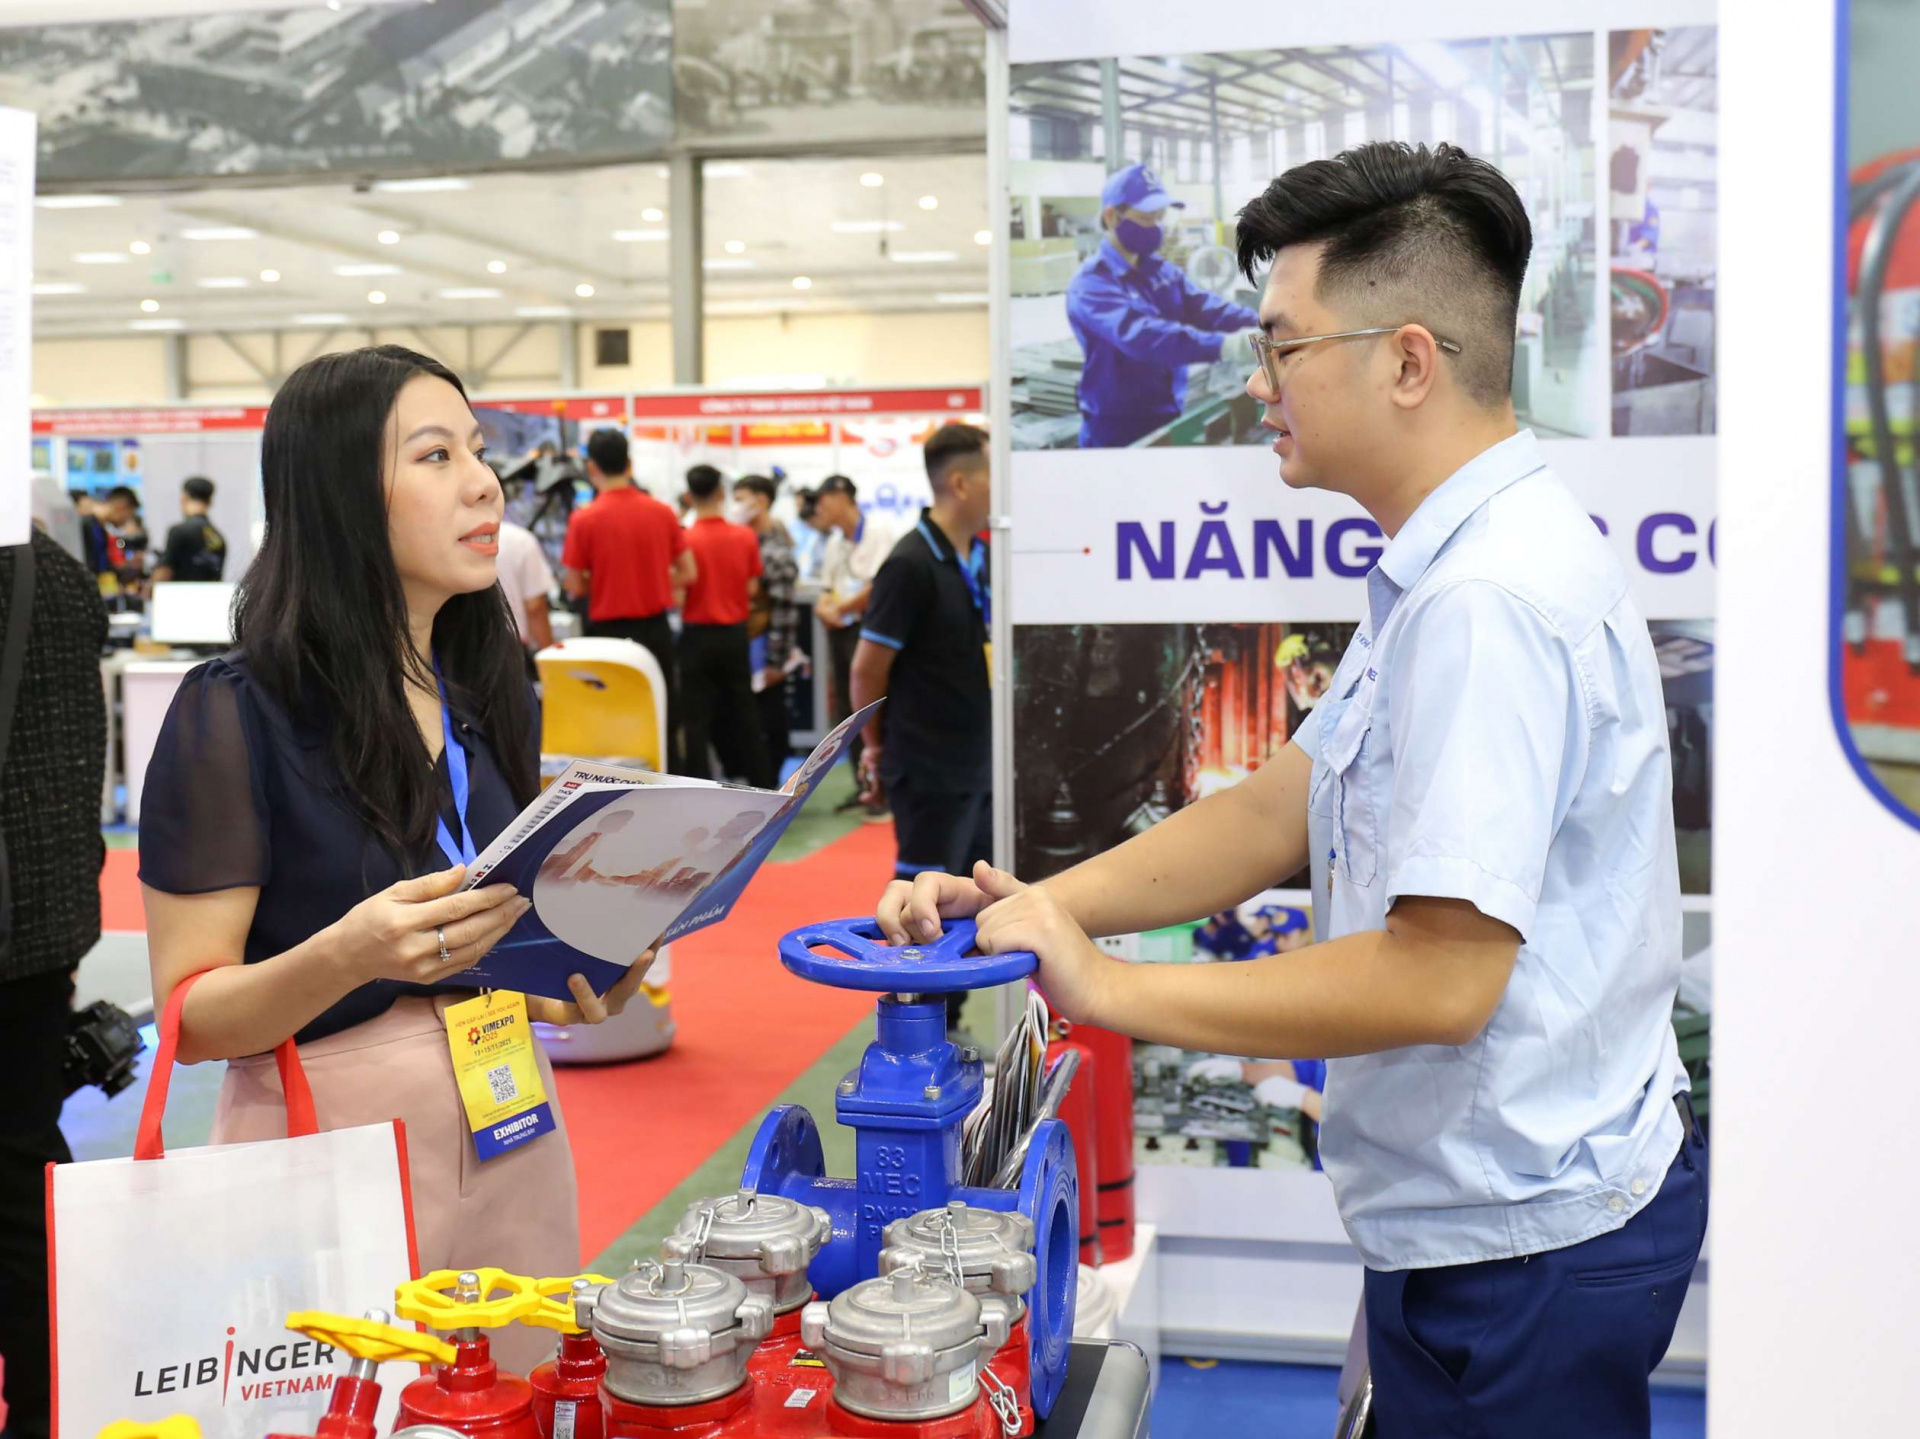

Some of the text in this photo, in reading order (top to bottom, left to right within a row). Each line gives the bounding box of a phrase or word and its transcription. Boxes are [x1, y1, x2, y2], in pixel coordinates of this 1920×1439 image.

[1115, 501, 1717, 581] NĂNG C
[481, 1014, 515, 1034] VIMEXPO
[493, 1113, 539, 1141] EXHIBITOR
[877, 1145, 905, 1168] 83
[862, 1171, 920, 1196] MEC
[241, 1373, 334, 1401] VIETNAM
